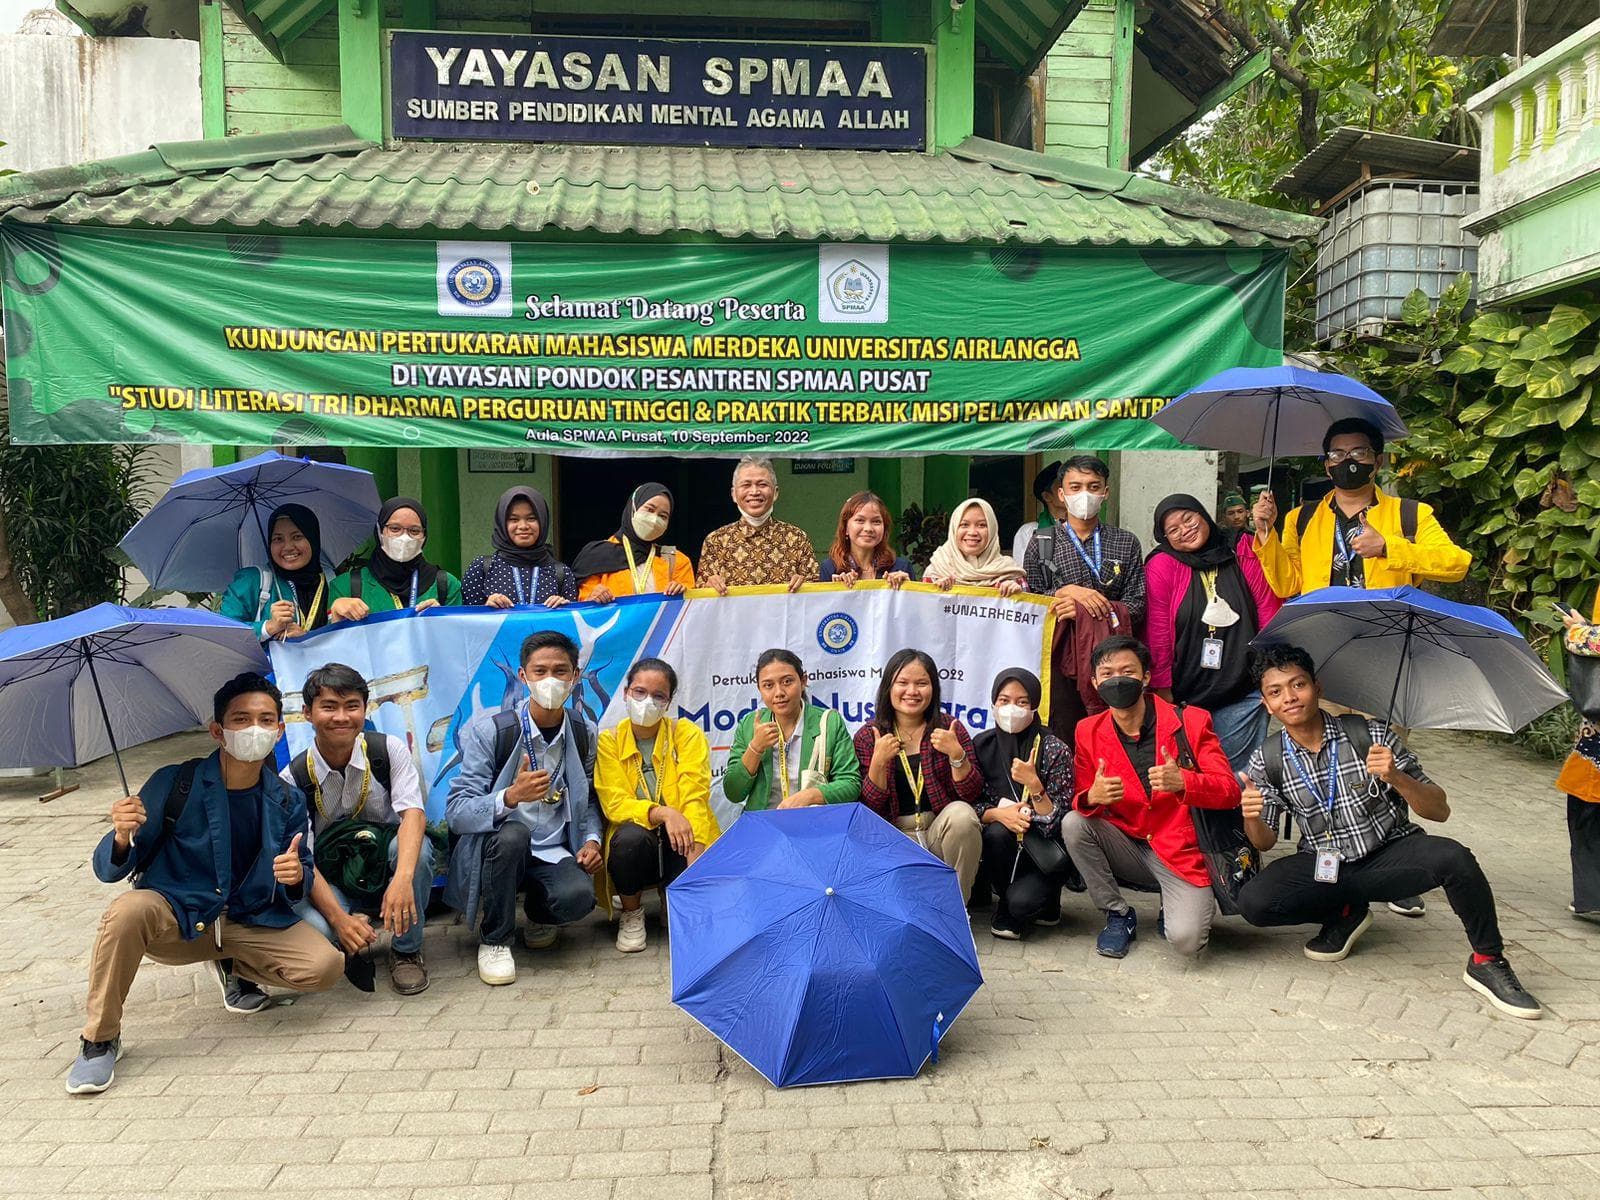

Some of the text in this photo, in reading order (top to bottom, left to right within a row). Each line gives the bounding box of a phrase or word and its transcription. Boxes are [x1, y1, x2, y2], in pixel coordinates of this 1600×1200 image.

[424, 47, 894, 99] YAYASAN SPMAA
[407, 98, 910, 130] SUMBER PENDIDIKAN MENTAL AGAMA ALLAH
[524, 294, 808, 327] Selamat Datang Peserta
[224, 327, 1081, 362] KUNJUNGAN PERTUKARAN MAHASISWA MERDEKA UNIVERSITAS AIRLANGGA
[391, 363, 931, 393] DI YAYASAN PONDOK PESANTREN SPMAA PUSAT
[200, 388, 304, 414] LITERASI
[310, 393, 349, 416] TRI
[352, 394, 458, 420] DHARMA
[461, 397, 607, 423] PERGURUAN
[610, 399, 690, 424] TINGGI
[693, 400, 713, 424] &
[715, 400, 812, 425] PRAKTIK
[815, 401, 908, 425] TERBAIK
[911, 401, 960, 424] MISI
[963, 399, 1092, 423] PELAYANAN
[525, 427, 811, 446] Aula SPMAA Pusat, 10 September 2022
[942, 603, 1040, 626] #UNAIRHEBAT
[711, 673, 757, 687] Pertuk
[805, 666, 866, 682] ahasiswa
[938, 668, 965, 683] 022
